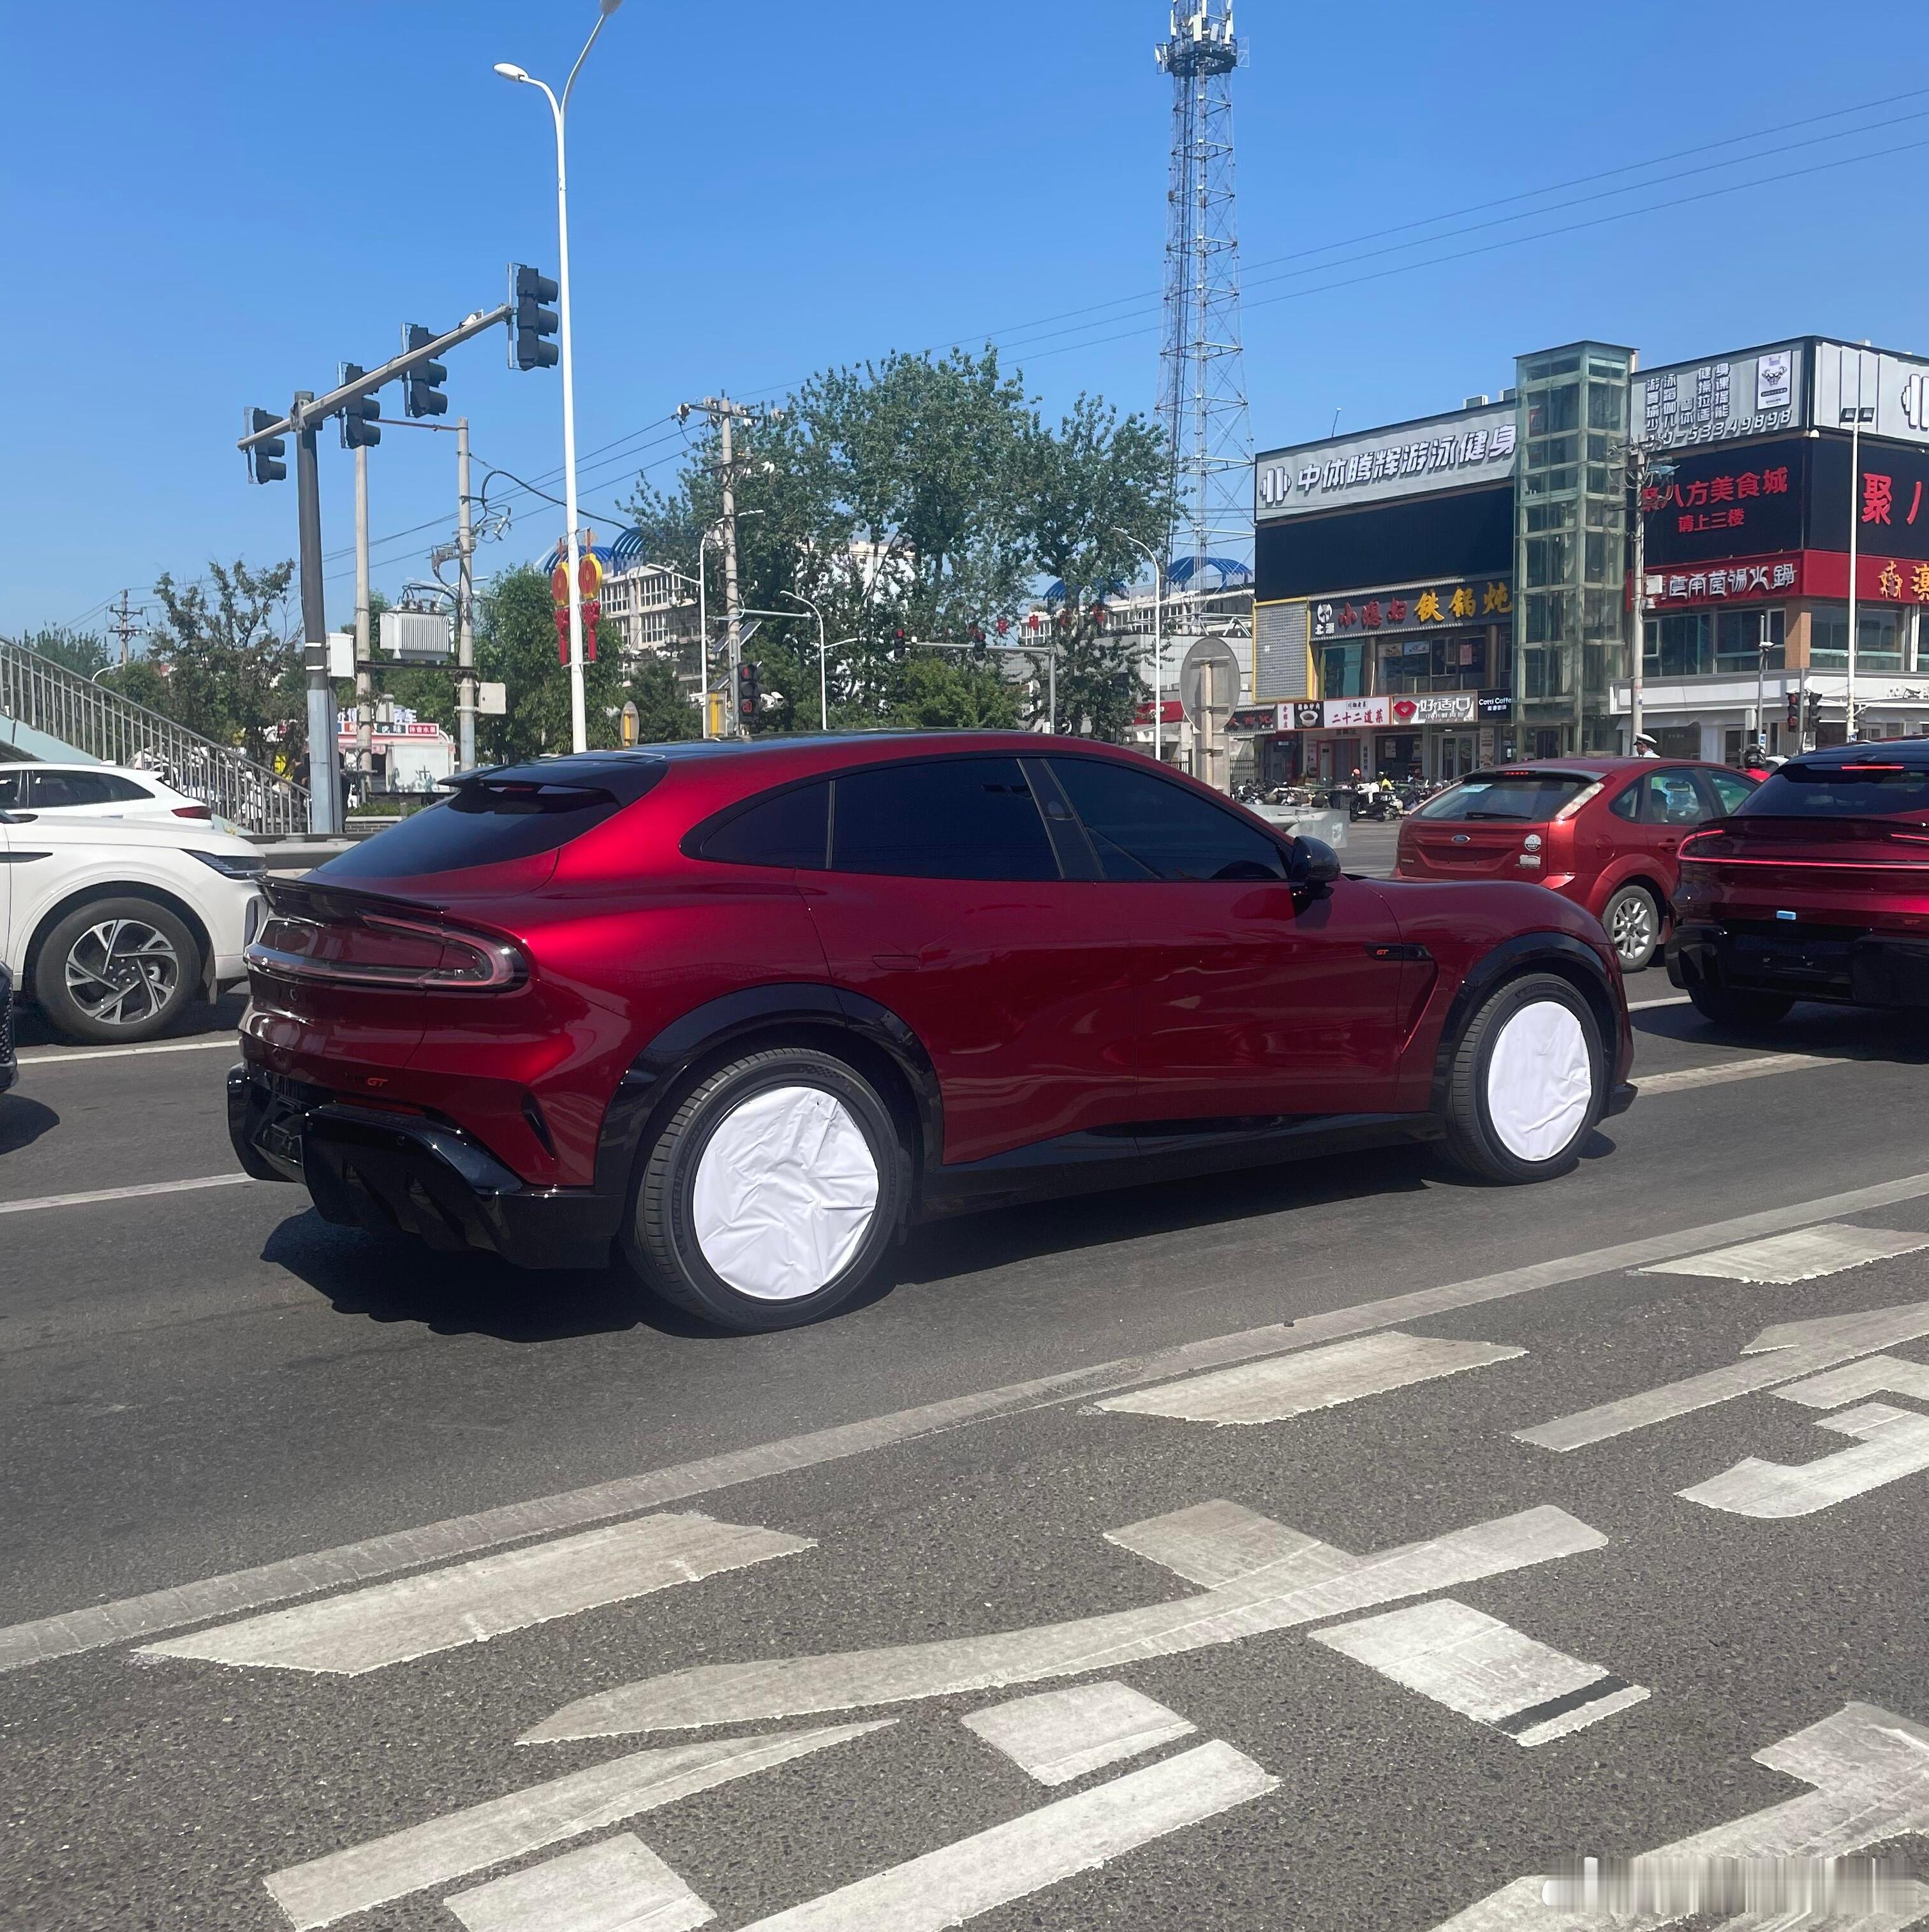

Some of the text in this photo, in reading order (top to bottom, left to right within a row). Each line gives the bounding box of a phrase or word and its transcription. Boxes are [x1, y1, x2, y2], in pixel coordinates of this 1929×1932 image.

[1646, 362, 1730, 392] 游泳 健身
[1645, 409, 1792, 448] 0-53349898
[1297, 424, 1517, 492] 中体腾辉游泳健身
[1678, 508, 1745, 533] 请上三楼
[1332, 708, 1384, 725] 二十二道菜
[367, 1077, 388, 1087] GT
